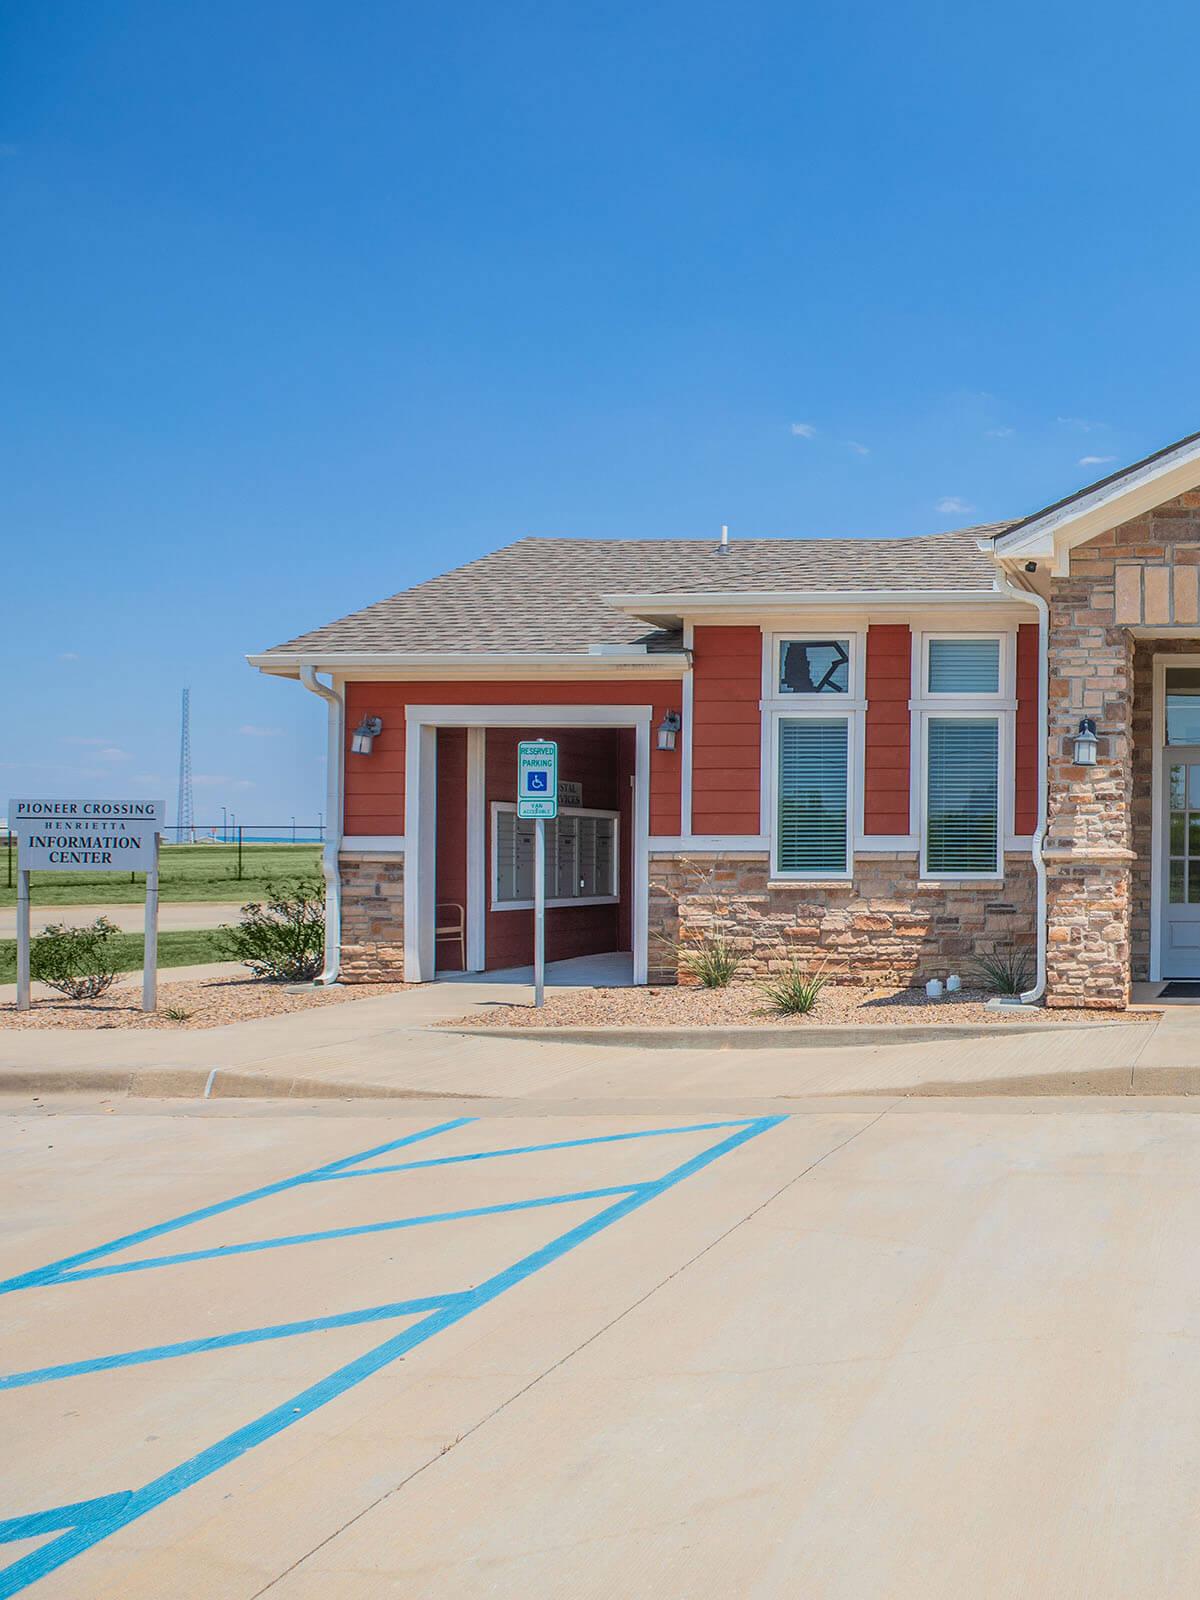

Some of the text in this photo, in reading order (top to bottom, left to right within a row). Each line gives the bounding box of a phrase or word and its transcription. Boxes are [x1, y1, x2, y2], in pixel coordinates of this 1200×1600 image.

[520, 747, 554, 755] RESERVED
[522, 759, 552, 768] PARKING
[18, 803, 155, 815] PIONEER CROSSING
[45, 822, 126, 830] HENRIETTA
[29, 836, 141, 849] INFORMATION
[49, 851, 112, 864] CENTER
